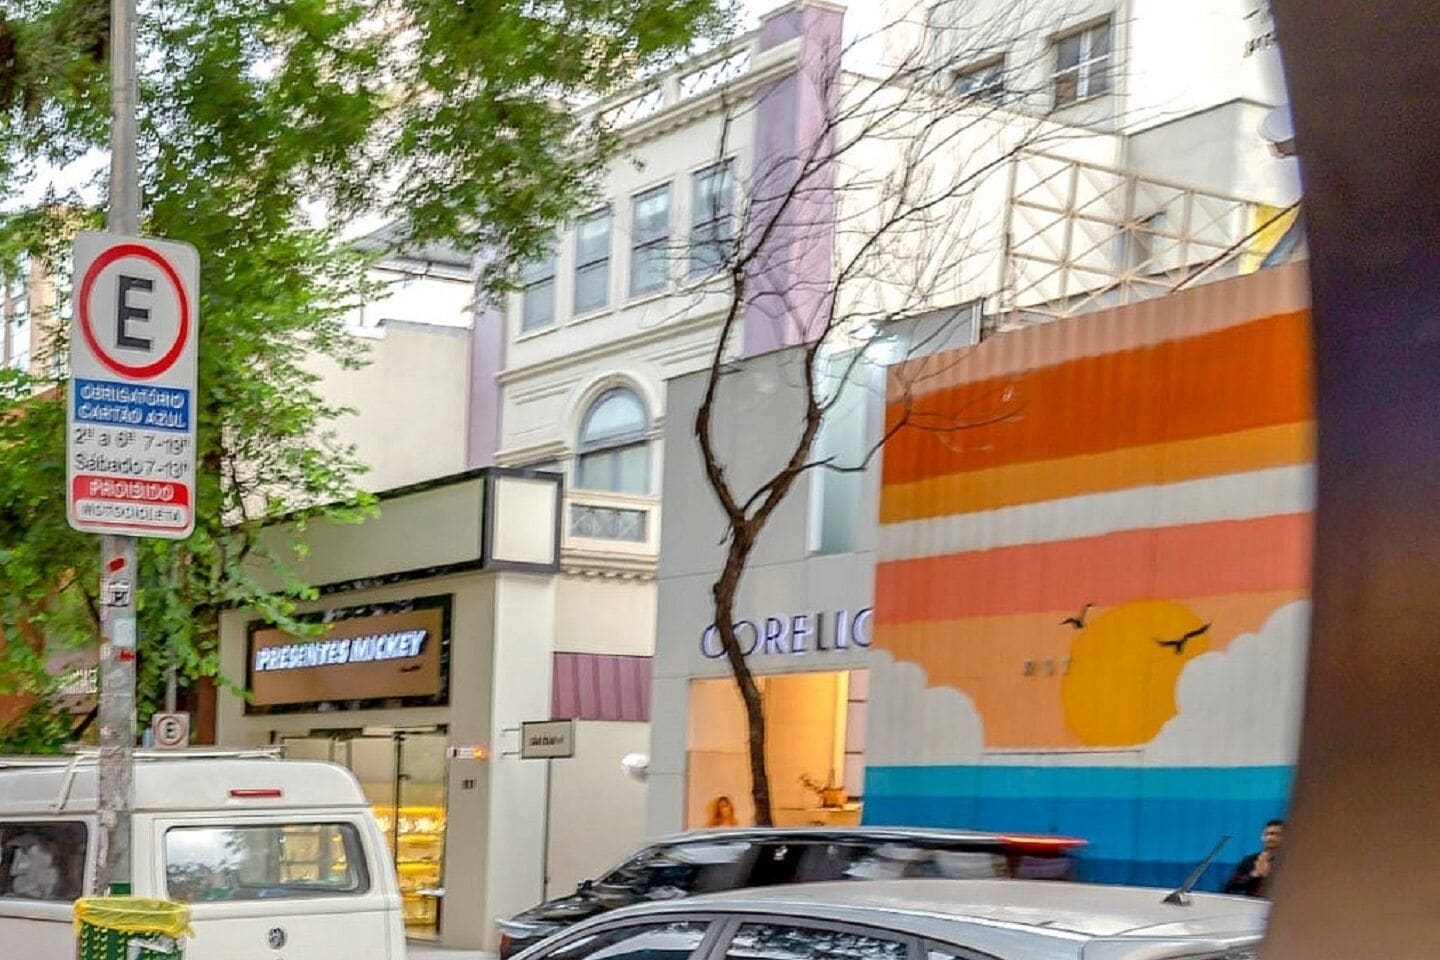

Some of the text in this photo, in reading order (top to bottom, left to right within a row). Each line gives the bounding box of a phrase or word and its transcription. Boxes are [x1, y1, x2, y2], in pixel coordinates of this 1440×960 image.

[116, 274, 154, 351] E
[144, 409, 186, 428] AZUL
[88, 479, 175, 502] PROIBIDO
[255, 630, 427, 671] PRESENTES MICKEY
[164, 721, 178, 739] E
